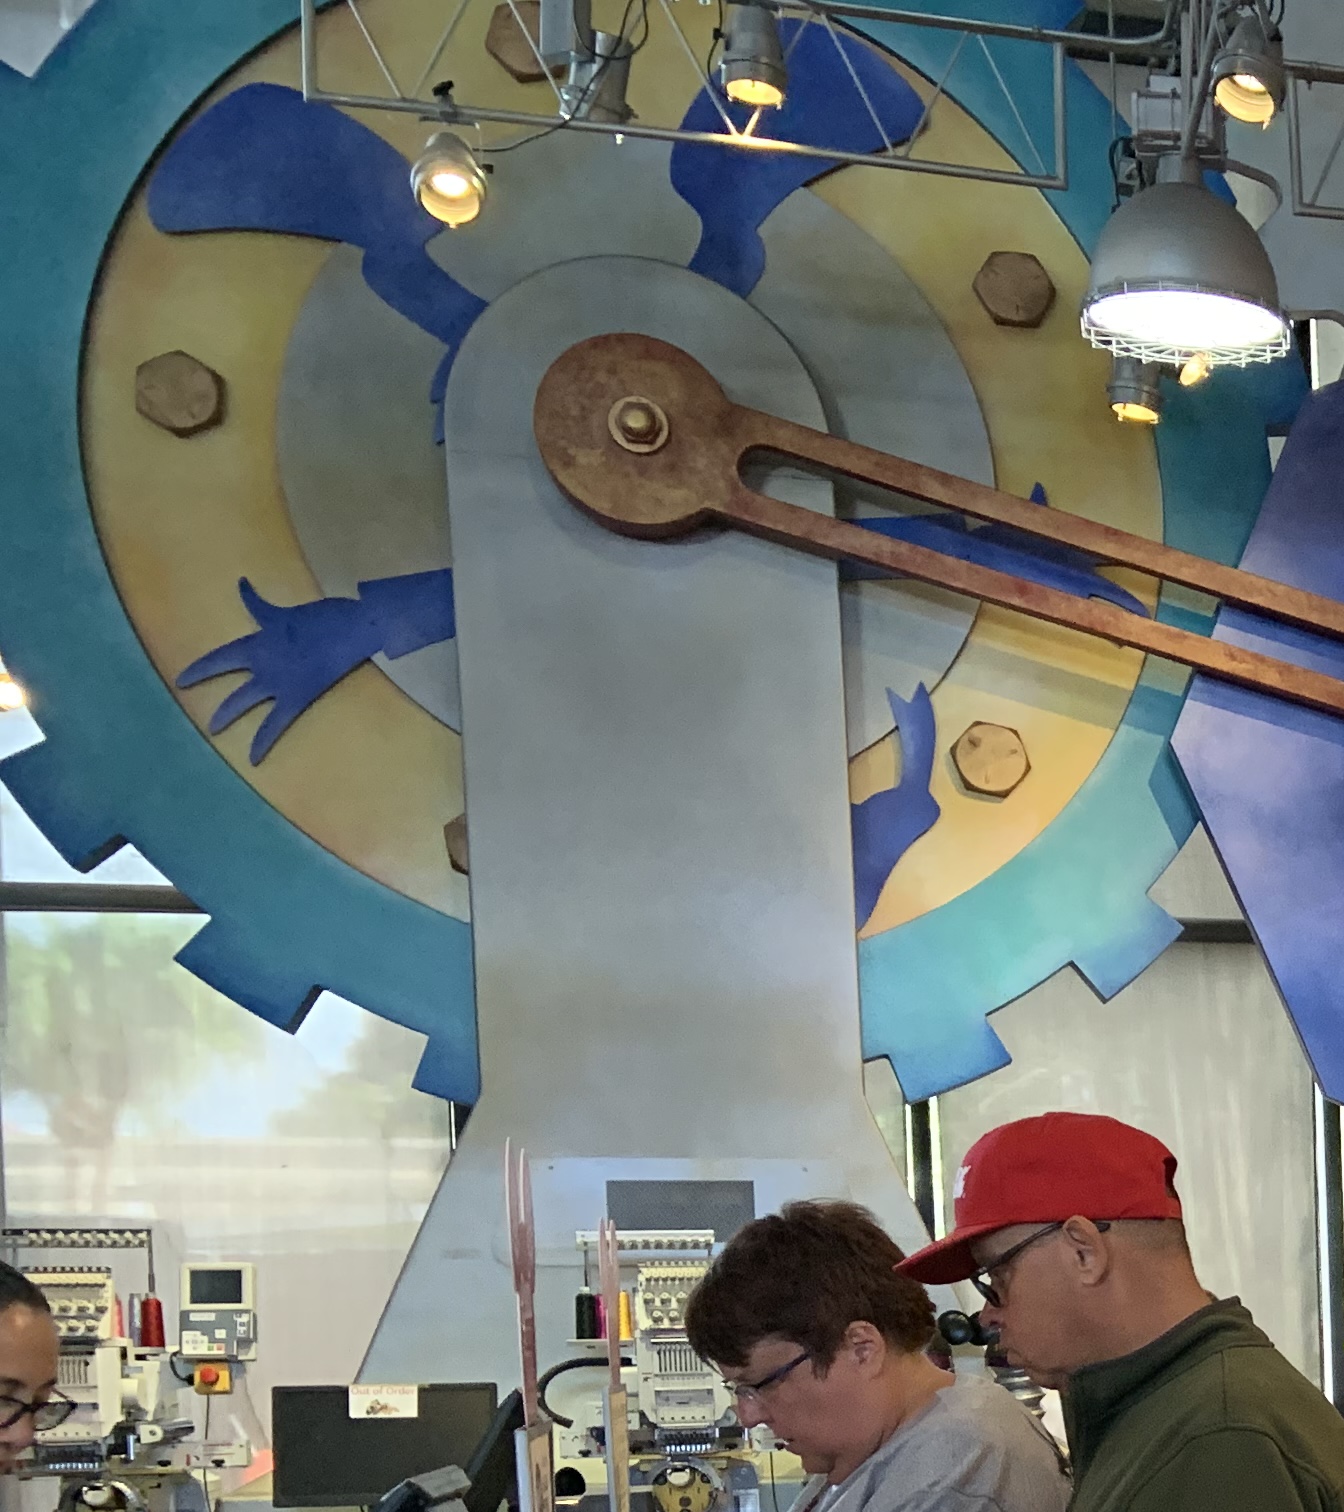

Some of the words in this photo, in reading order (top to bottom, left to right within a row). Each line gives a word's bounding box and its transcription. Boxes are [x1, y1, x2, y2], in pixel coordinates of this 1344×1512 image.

[351, 1385, 369, 1395] Out
[373, 1385, 383, 1395] of
[386, 1385, 414, 1395] Order
